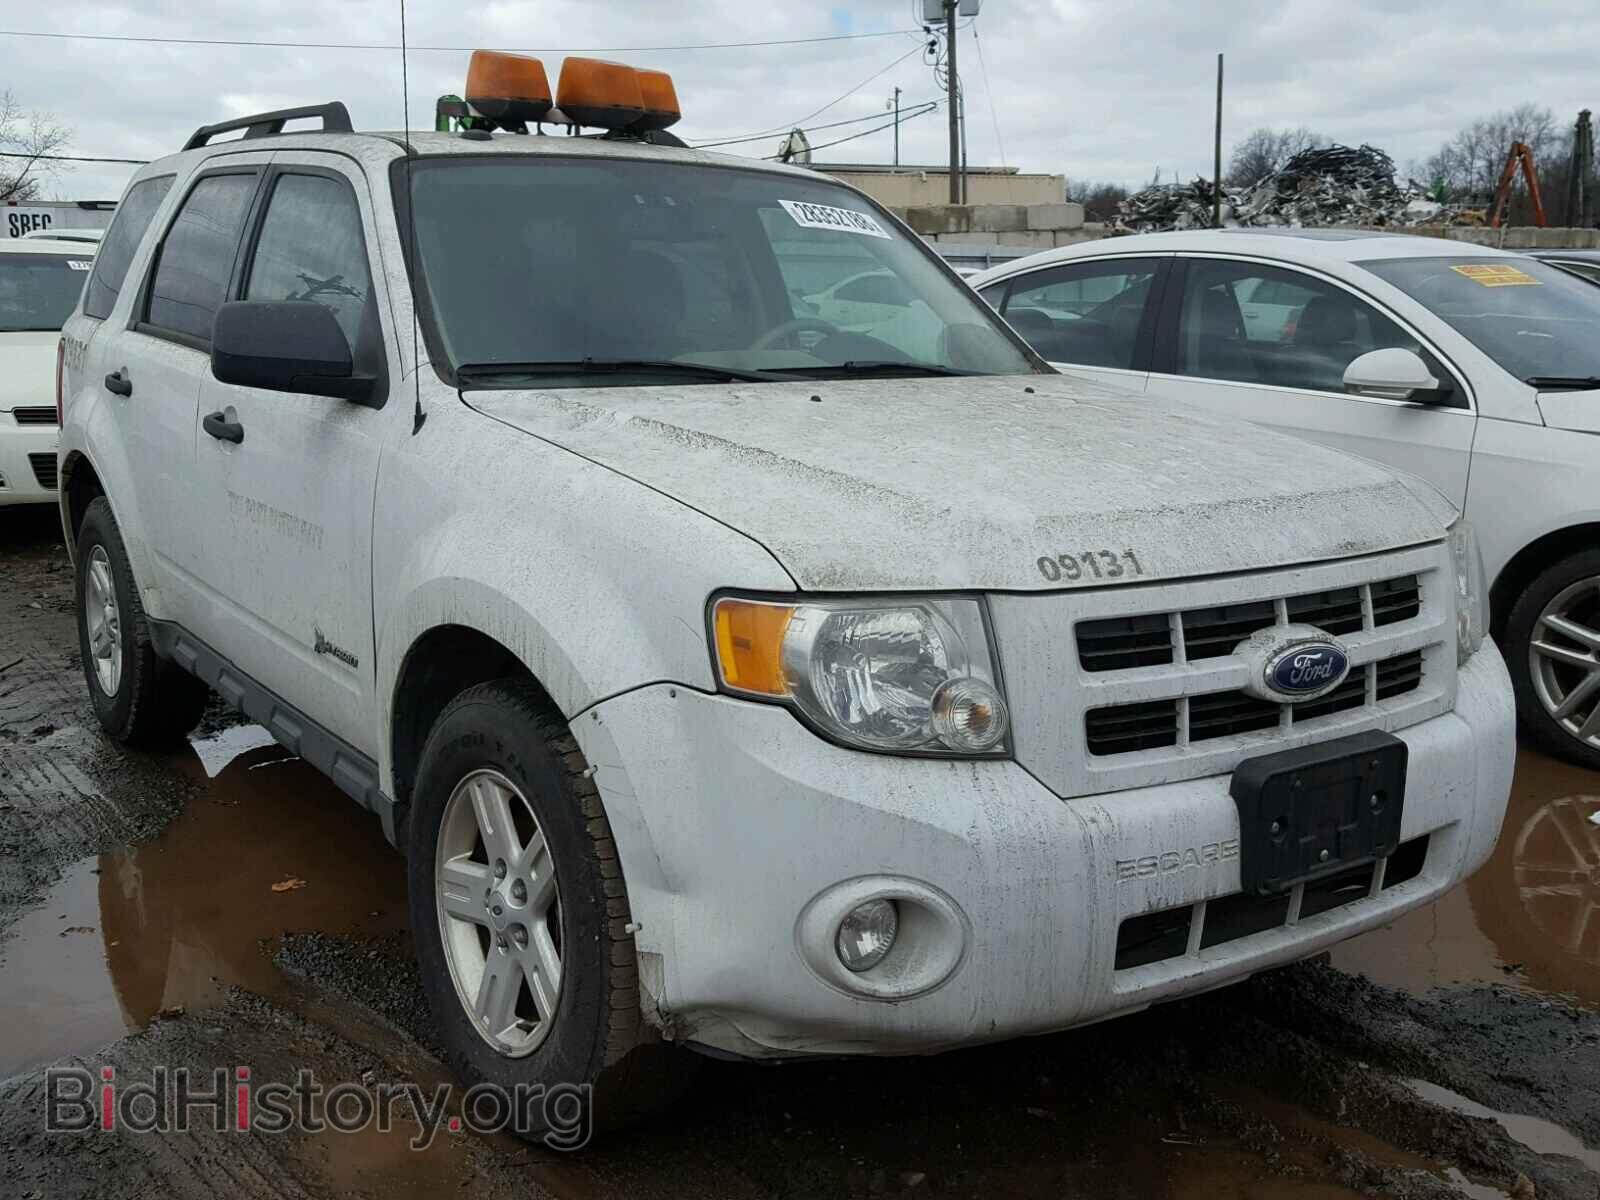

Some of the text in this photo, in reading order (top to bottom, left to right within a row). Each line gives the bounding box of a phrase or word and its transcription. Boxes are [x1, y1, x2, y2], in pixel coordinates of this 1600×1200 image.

[1036, 549, 1144, 581] 09131
[1290, 652, 1334, 684] Ford
[1115, 839, 1240, 883] ESCAPE
